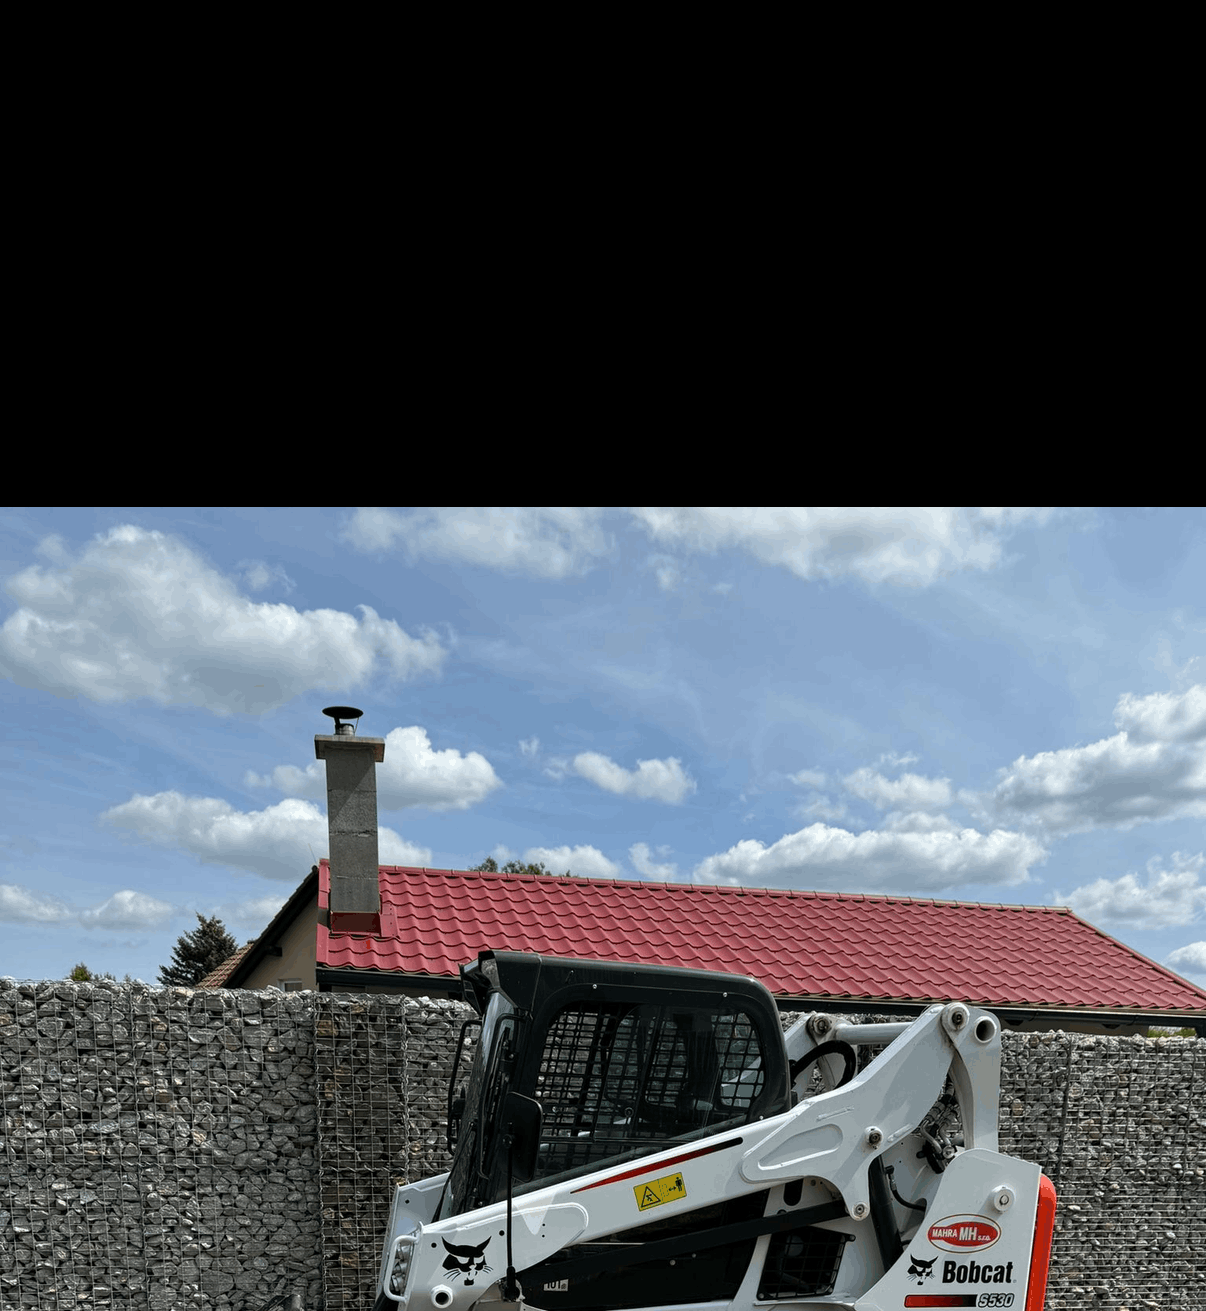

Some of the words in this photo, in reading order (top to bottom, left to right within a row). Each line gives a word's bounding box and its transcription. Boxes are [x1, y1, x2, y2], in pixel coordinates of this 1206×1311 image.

[932, 1228, 958, 1238] MAHRA
[958, 1226, 978, 1241] MH
[941, 1260, 1014, 1284] Bobcat
[977, 1292, 1015, 1308] S530
